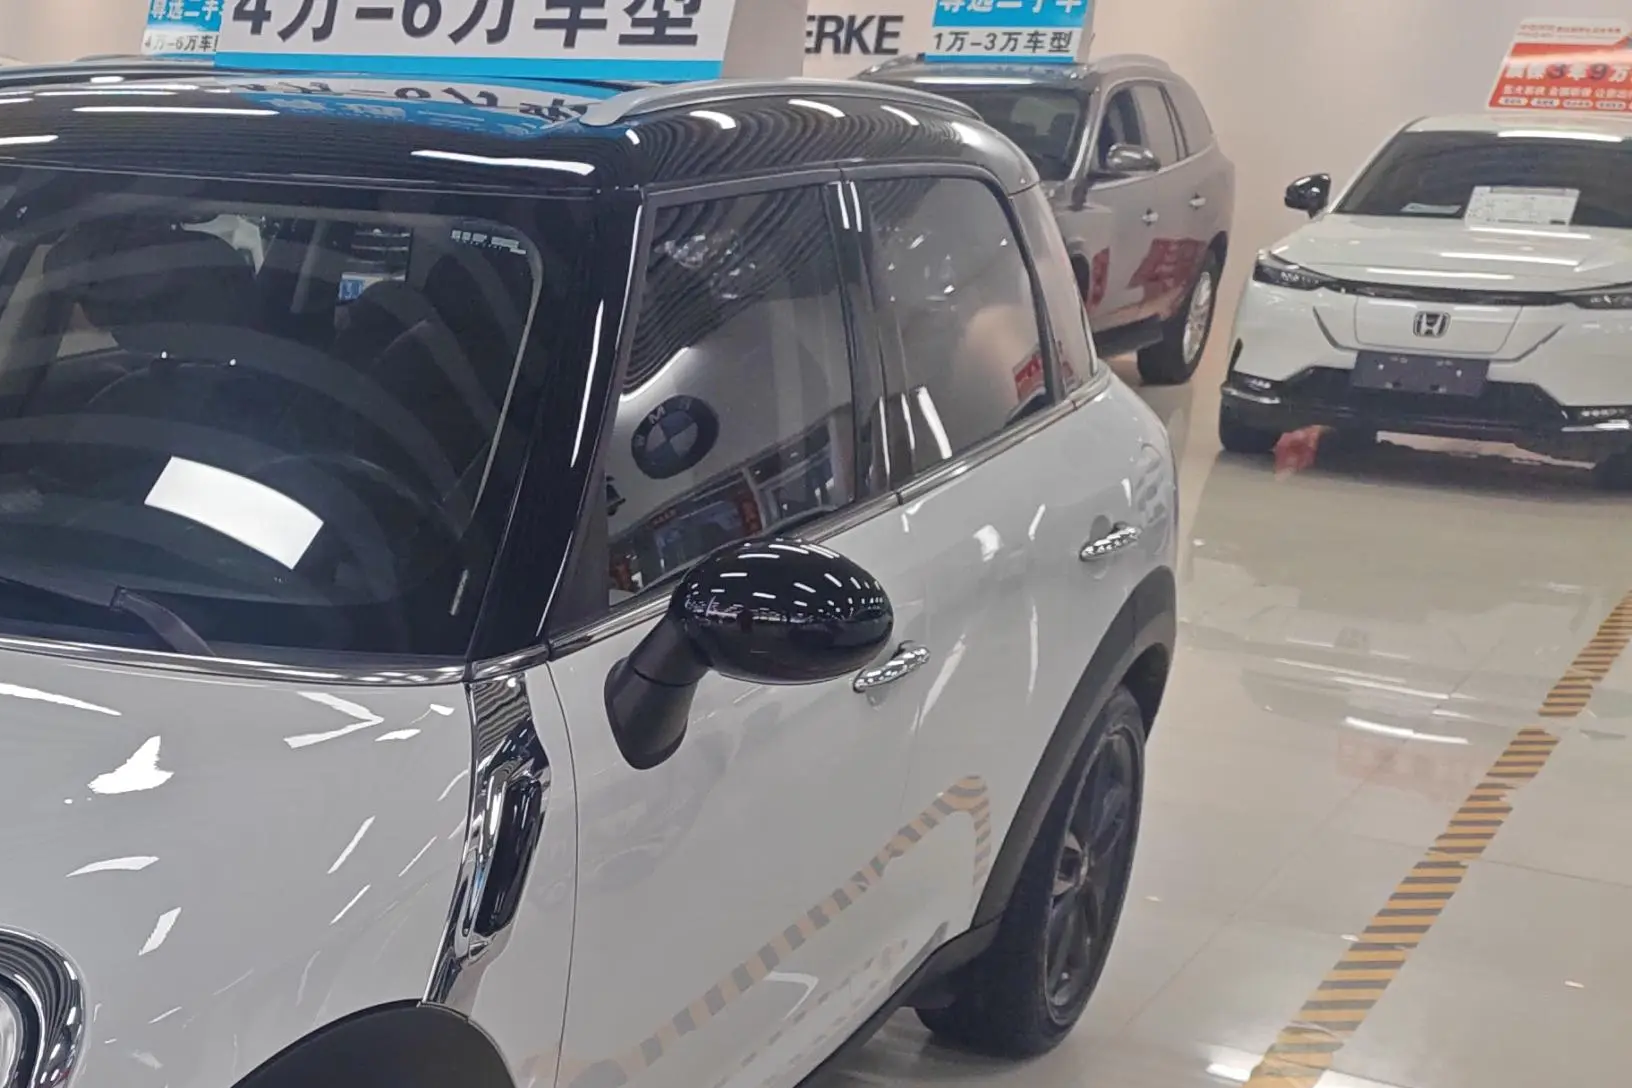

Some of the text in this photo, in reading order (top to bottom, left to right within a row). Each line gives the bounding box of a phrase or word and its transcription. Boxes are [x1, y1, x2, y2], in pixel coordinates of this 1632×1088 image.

[232, 0, 699, 48] 4万-6万车型
[933, 30, 1073, 52] 1万-3万车型
